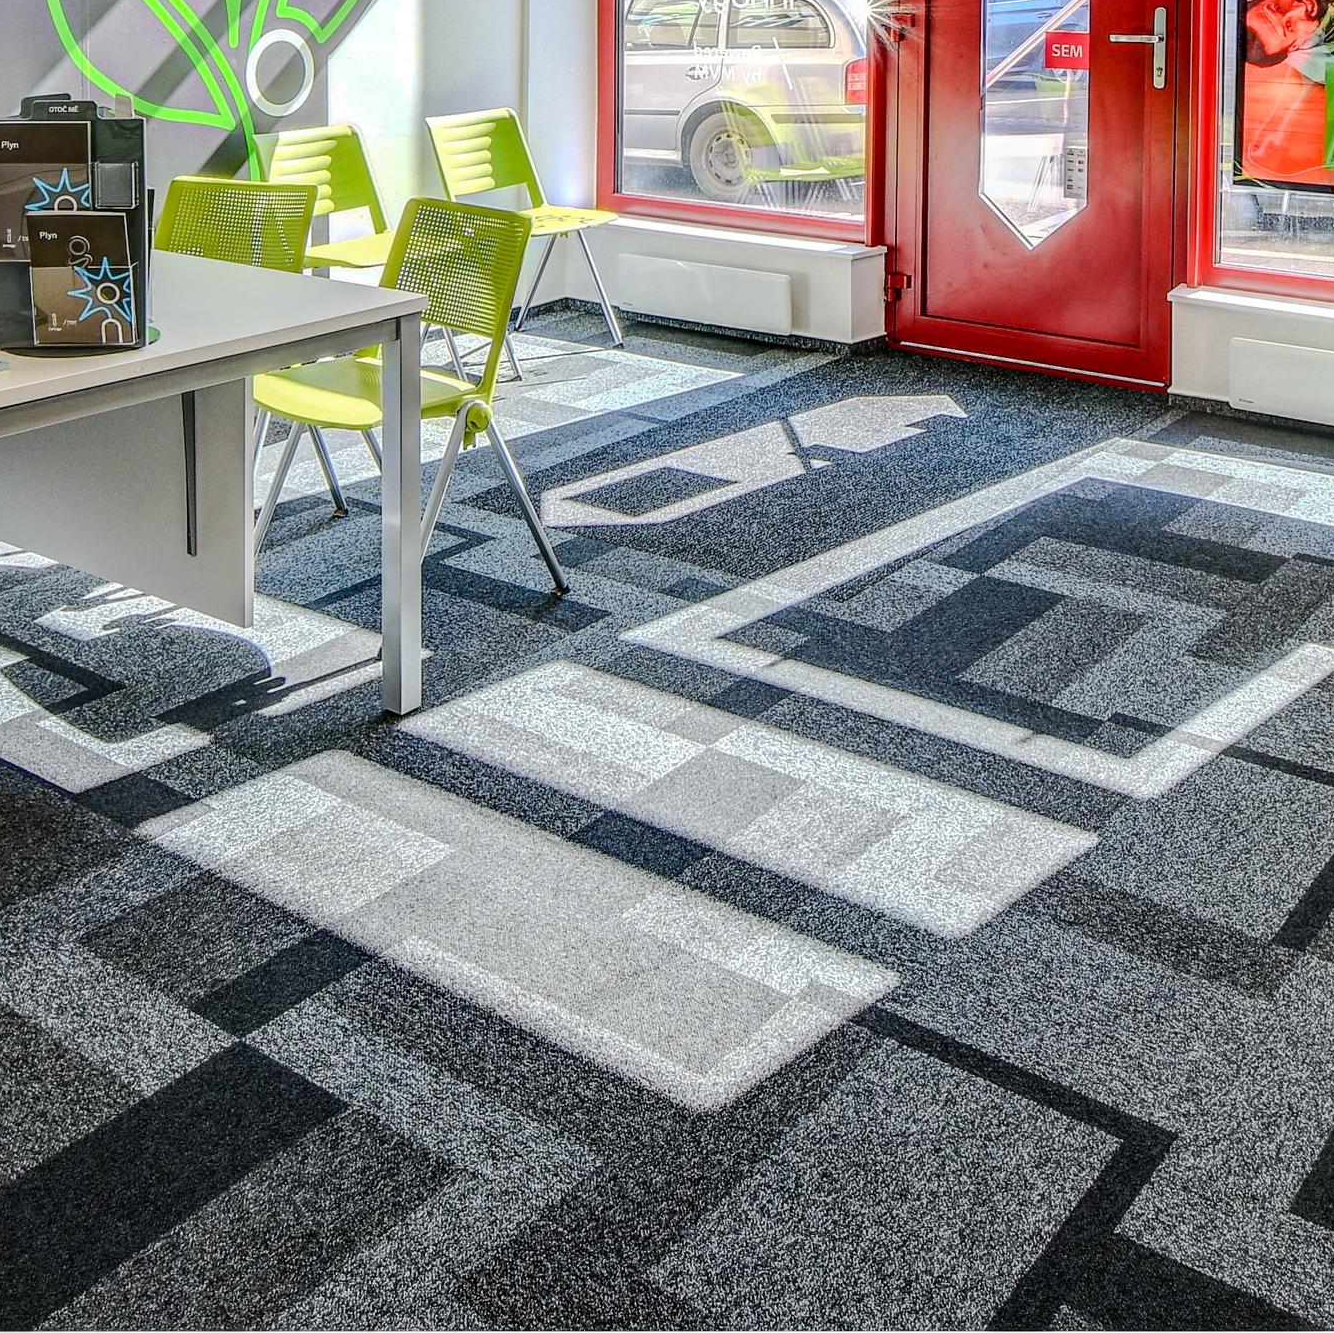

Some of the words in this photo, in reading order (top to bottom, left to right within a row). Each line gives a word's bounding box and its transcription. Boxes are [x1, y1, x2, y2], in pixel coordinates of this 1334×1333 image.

[1051, 44, 1083, 58] SEM
[1, 141, 19, 150] Plyn
[39, 231, 58, 240] Plyn
